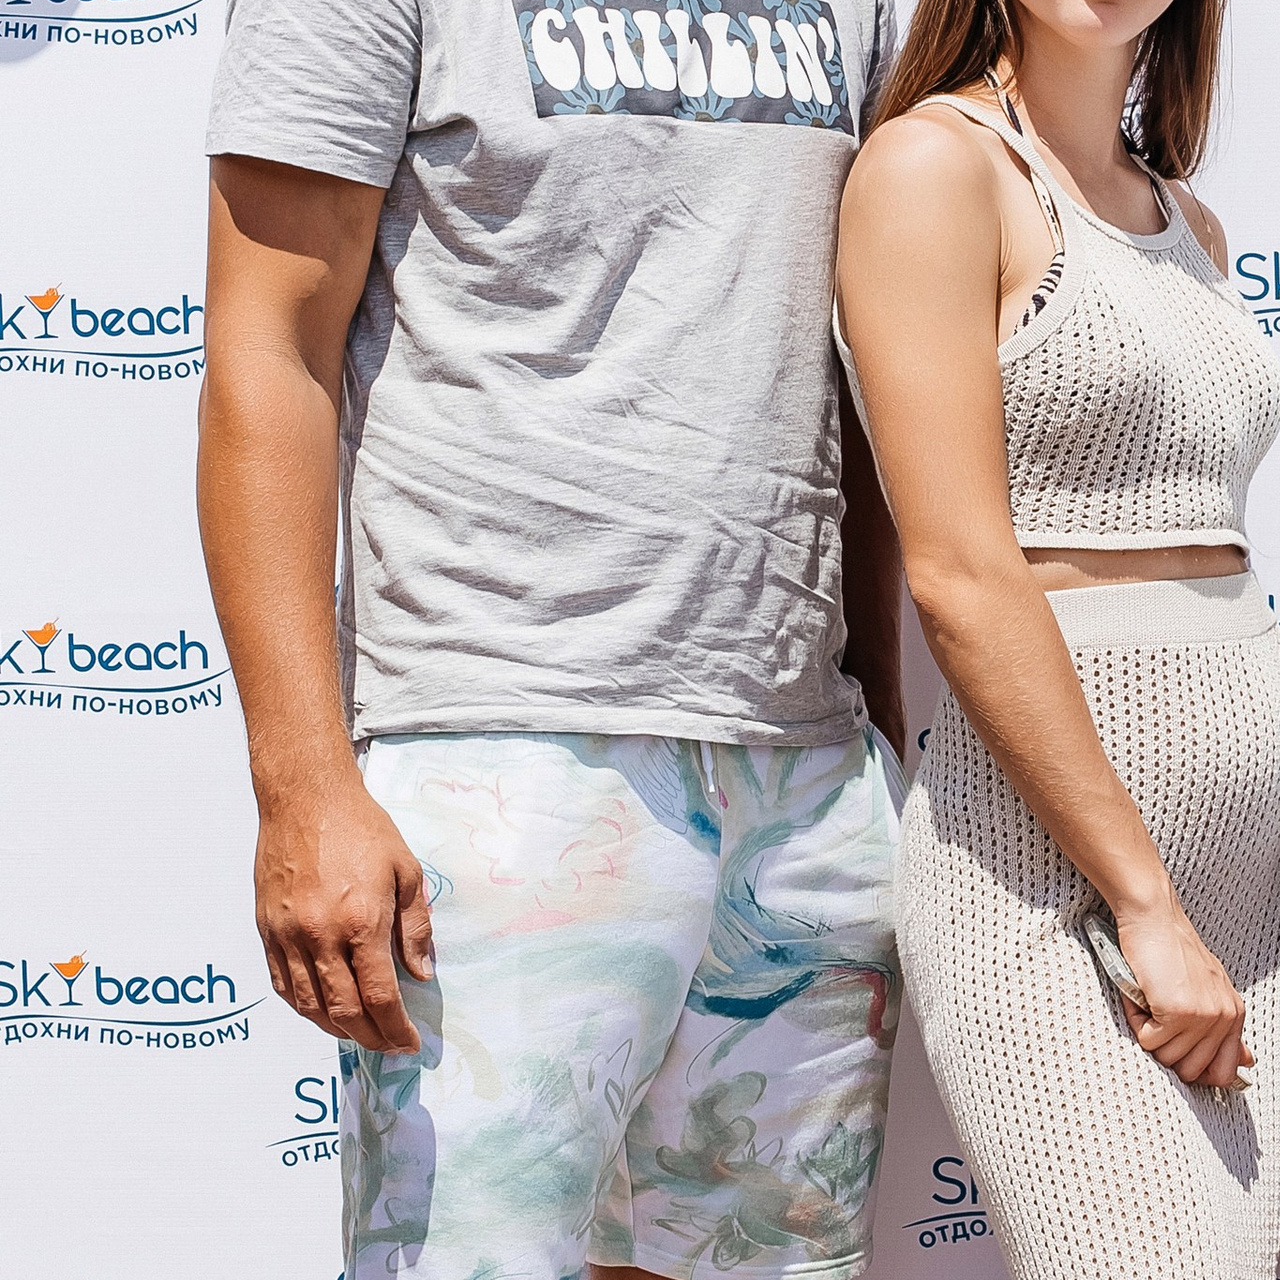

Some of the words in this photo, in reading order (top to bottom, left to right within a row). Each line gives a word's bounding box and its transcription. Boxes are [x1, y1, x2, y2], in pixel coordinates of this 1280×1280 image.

[530, 5, 835, 107] CHILLIN'
[70, 294, 204, 338] beach
[67, 629, 209, 673] beach
[95, 963, 236, 1006] beach
